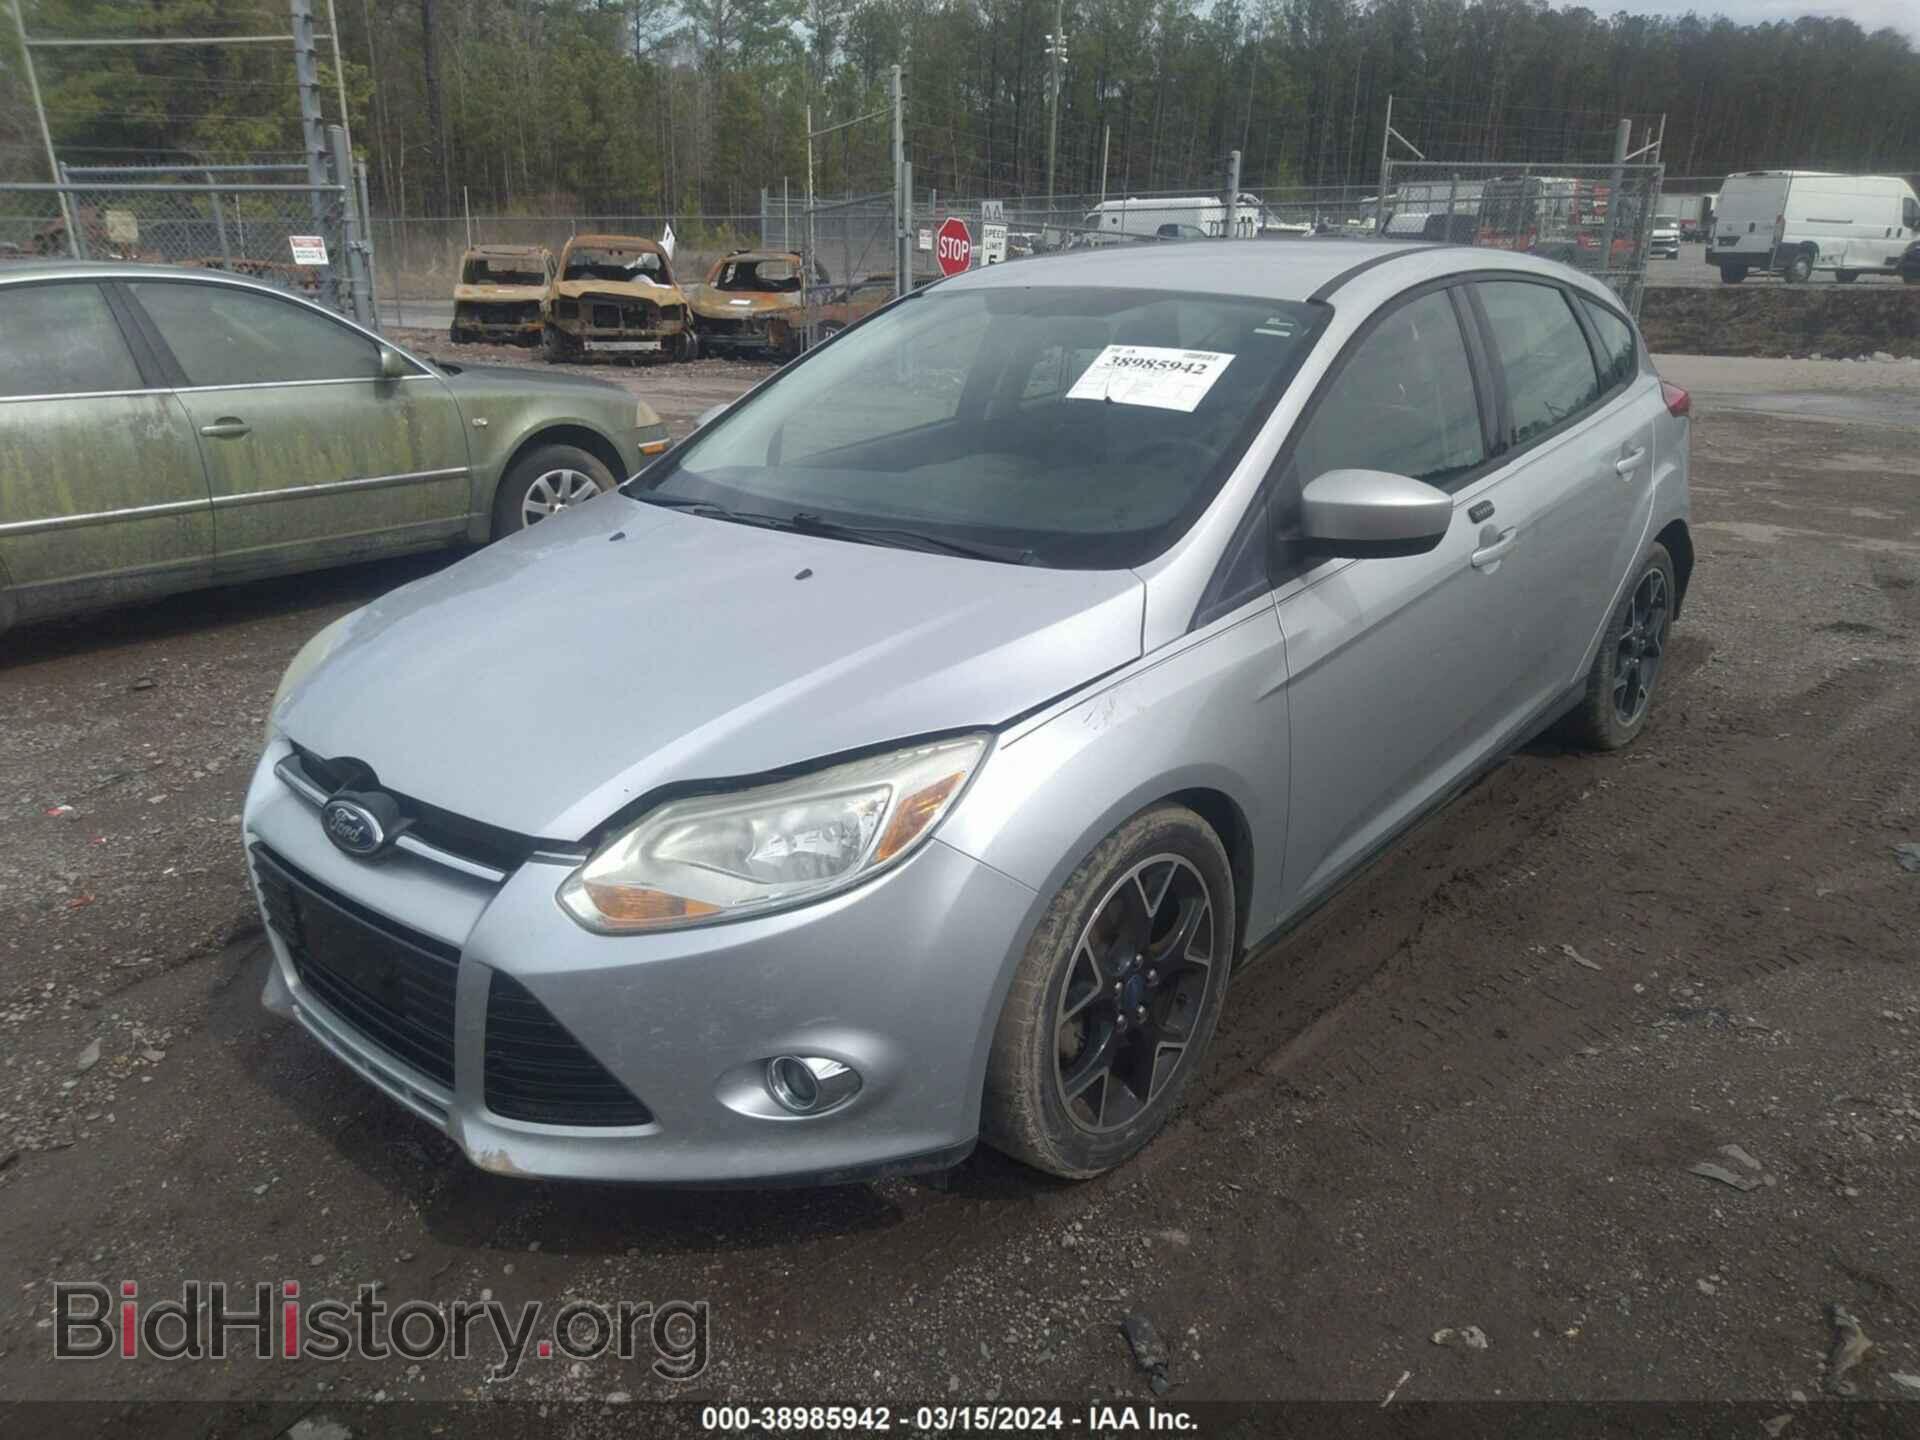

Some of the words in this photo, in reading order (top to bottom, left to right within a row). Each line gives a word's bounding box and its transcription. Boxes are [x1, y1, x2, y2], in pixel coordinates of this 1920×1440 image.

[985, 228, 1005, 239] SPEED
[940, 236, 969, 262] STOP
[985, 241, 1003, 250] LIMIT
[1104, 355, 1208, 375] 38985942
[331, 808, 365, 842] Ford
